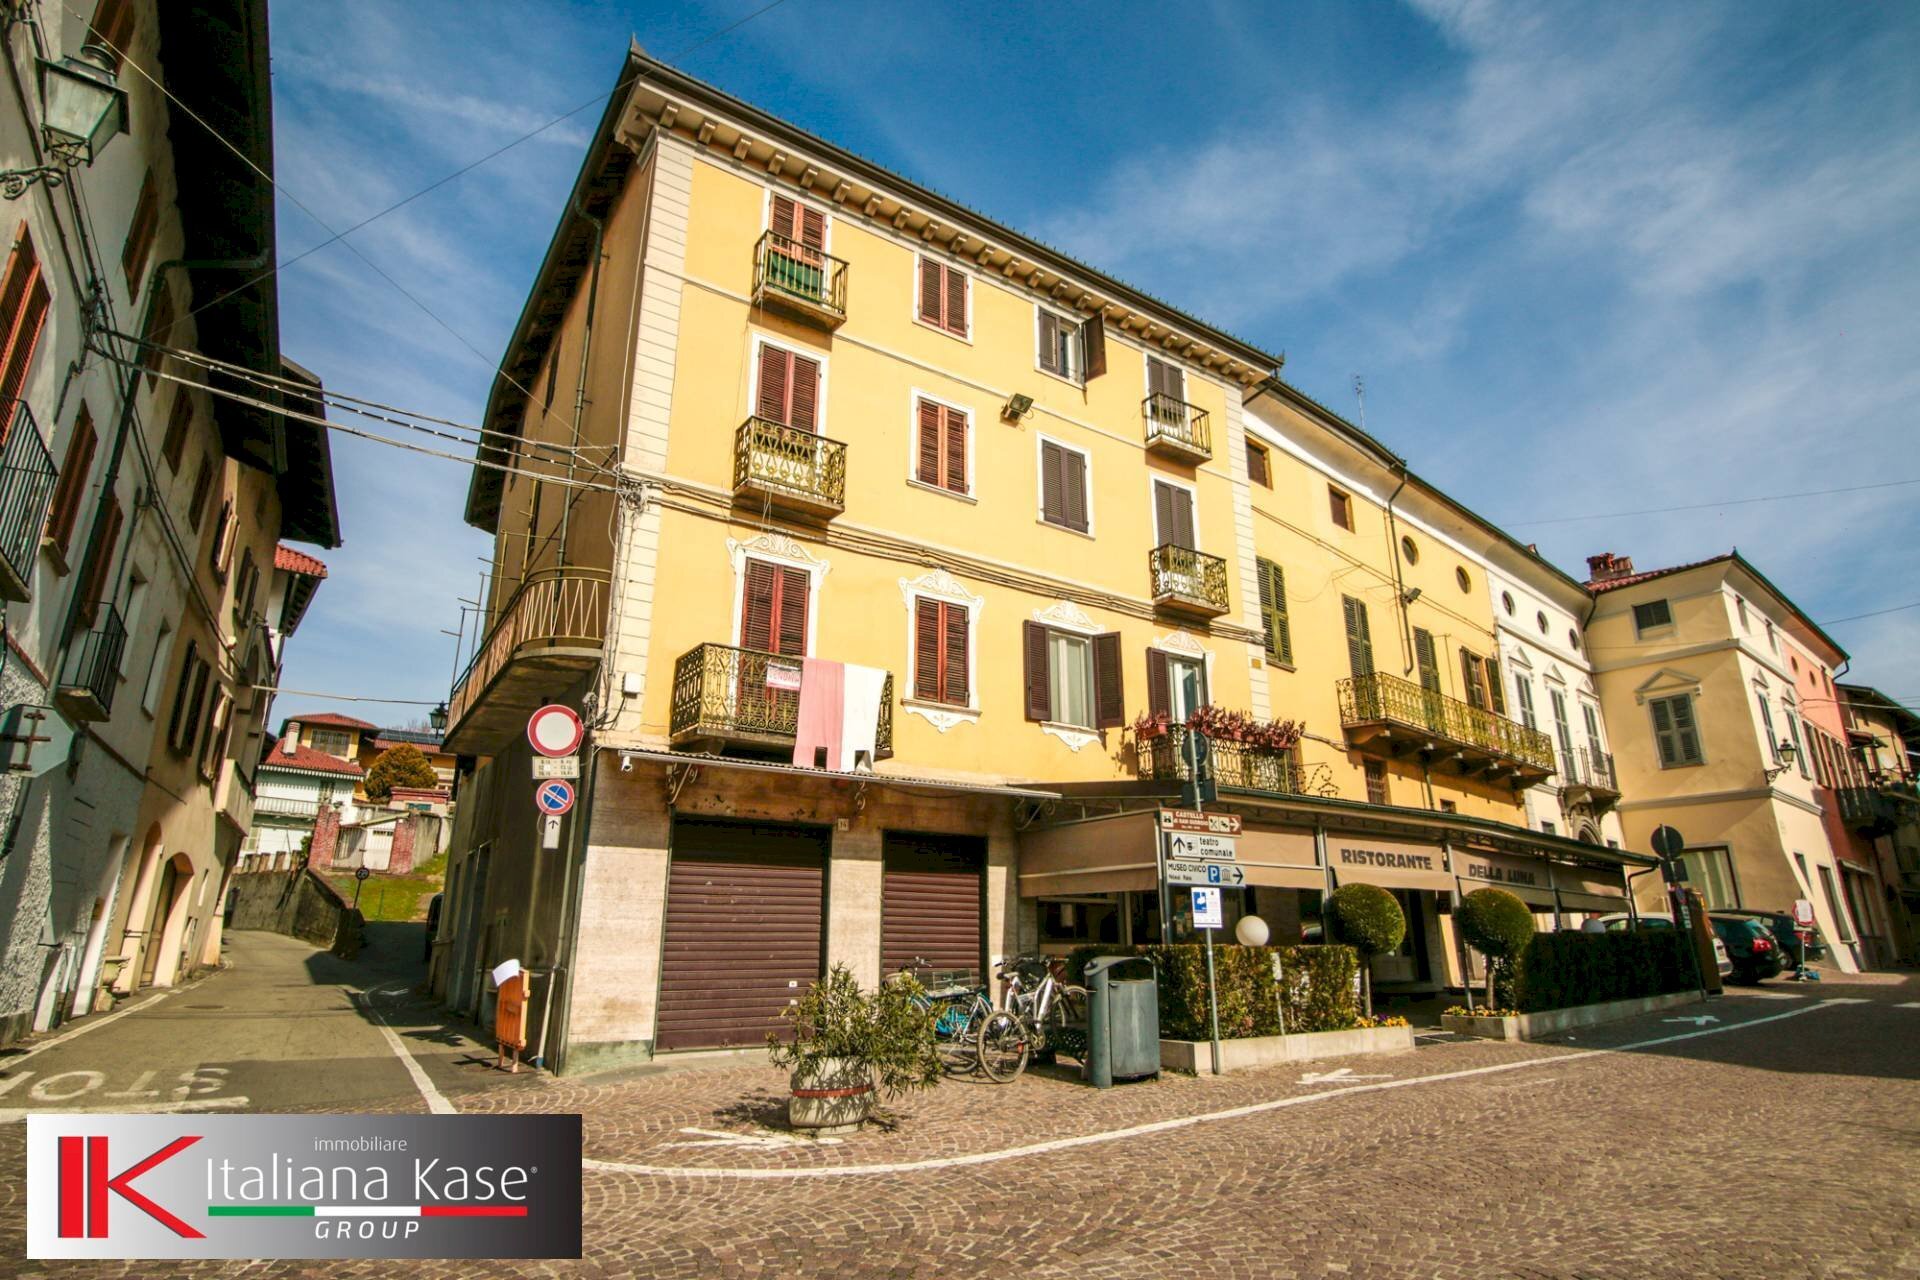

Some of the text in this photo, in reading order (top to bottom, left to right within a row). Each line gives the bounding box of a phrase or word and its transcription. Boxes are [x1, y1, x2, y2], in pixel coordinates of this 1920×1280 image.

[1199, 837, 1219, 846] teatro
[1200, 848, 1233, 858] comunale
[1340, 848, 1433, 870] RISTORANTE
[1168, 863, 1206, 873] MUSEO CIVICO
[1468, 863, 1535, 886] DELLA LUNA
